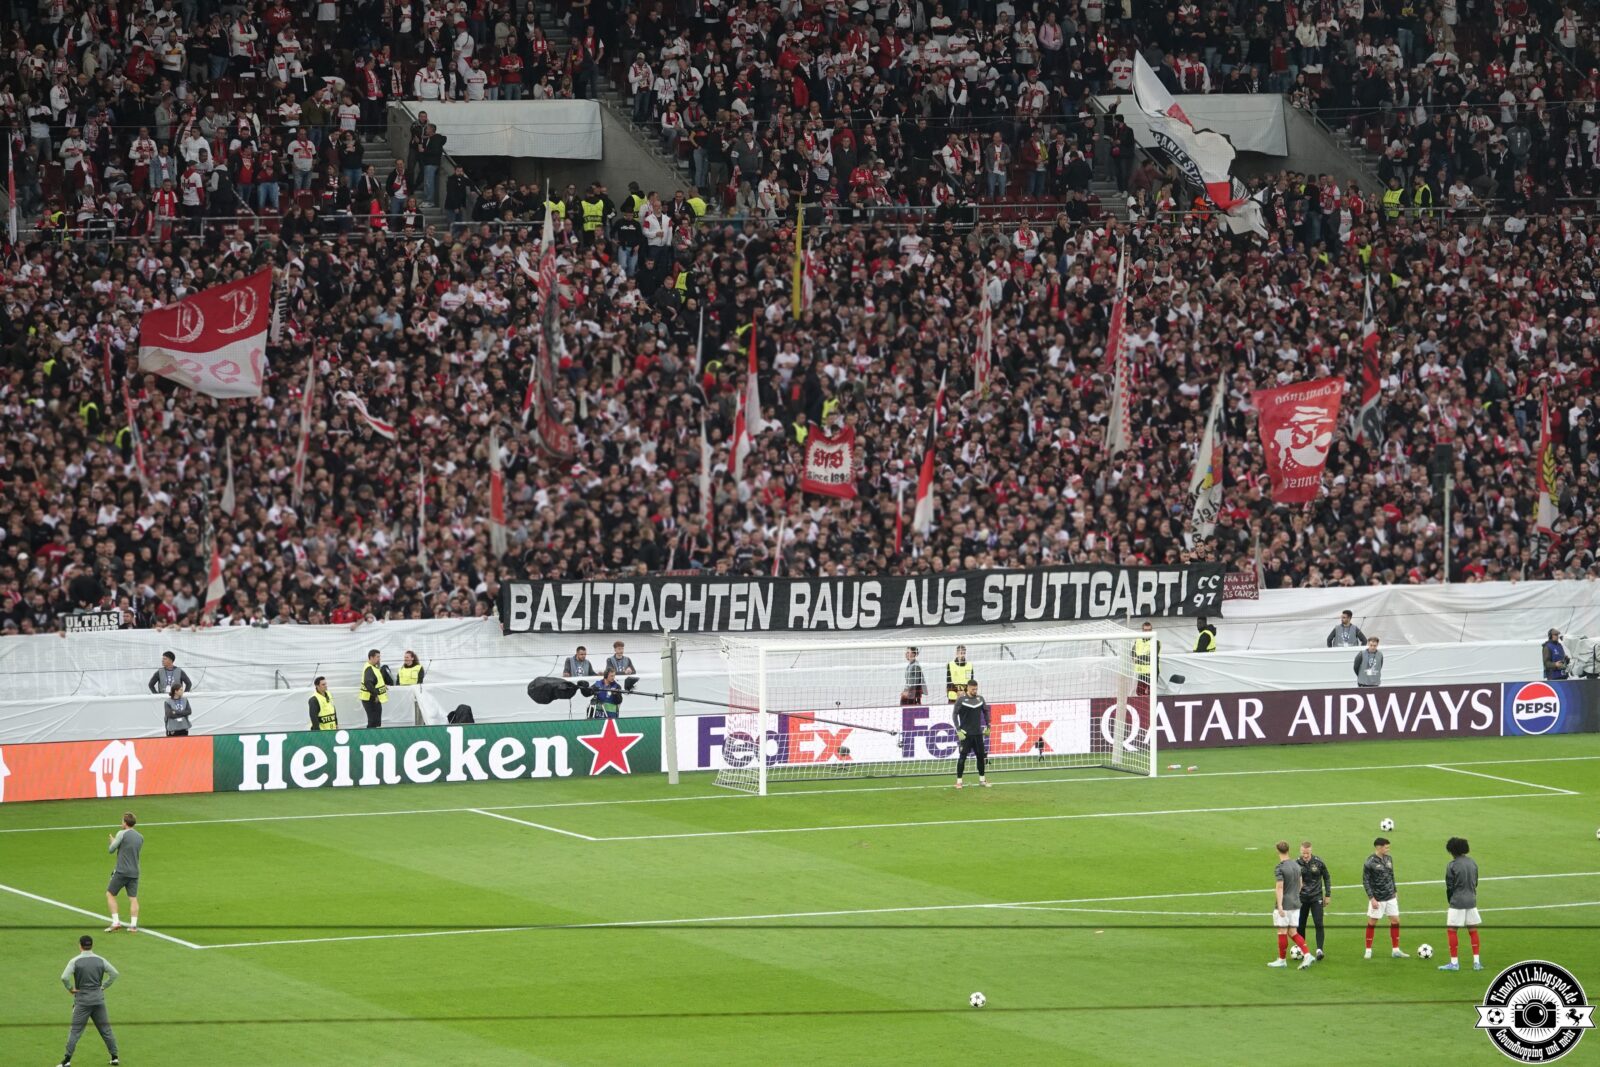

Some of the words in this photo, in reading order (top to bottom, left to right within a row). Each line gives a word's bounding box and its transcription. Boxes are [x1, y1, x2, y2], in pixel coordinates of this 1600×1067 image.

[1193, 592, 1216, 607] 97
[1197, 575, 1221, 589] CC
[509, 581, 773, 632] BAZITRACHTEN
[788, 580, 882, 630] RAUS
[896, 577, 967, 626] AUS
[981, 569, 1188, 621] STUTTGART!
[65, 613, 119, 628] ULTRAS
[1101, 698, 1266, 751] QATAR
[1287, 689, 1494, 737] AIRWAYS
[1515, 701, 1557, 715] PEPSI
[698, 711, 854, 768] FedEx
[238, 726, 572, 790] Heineken
